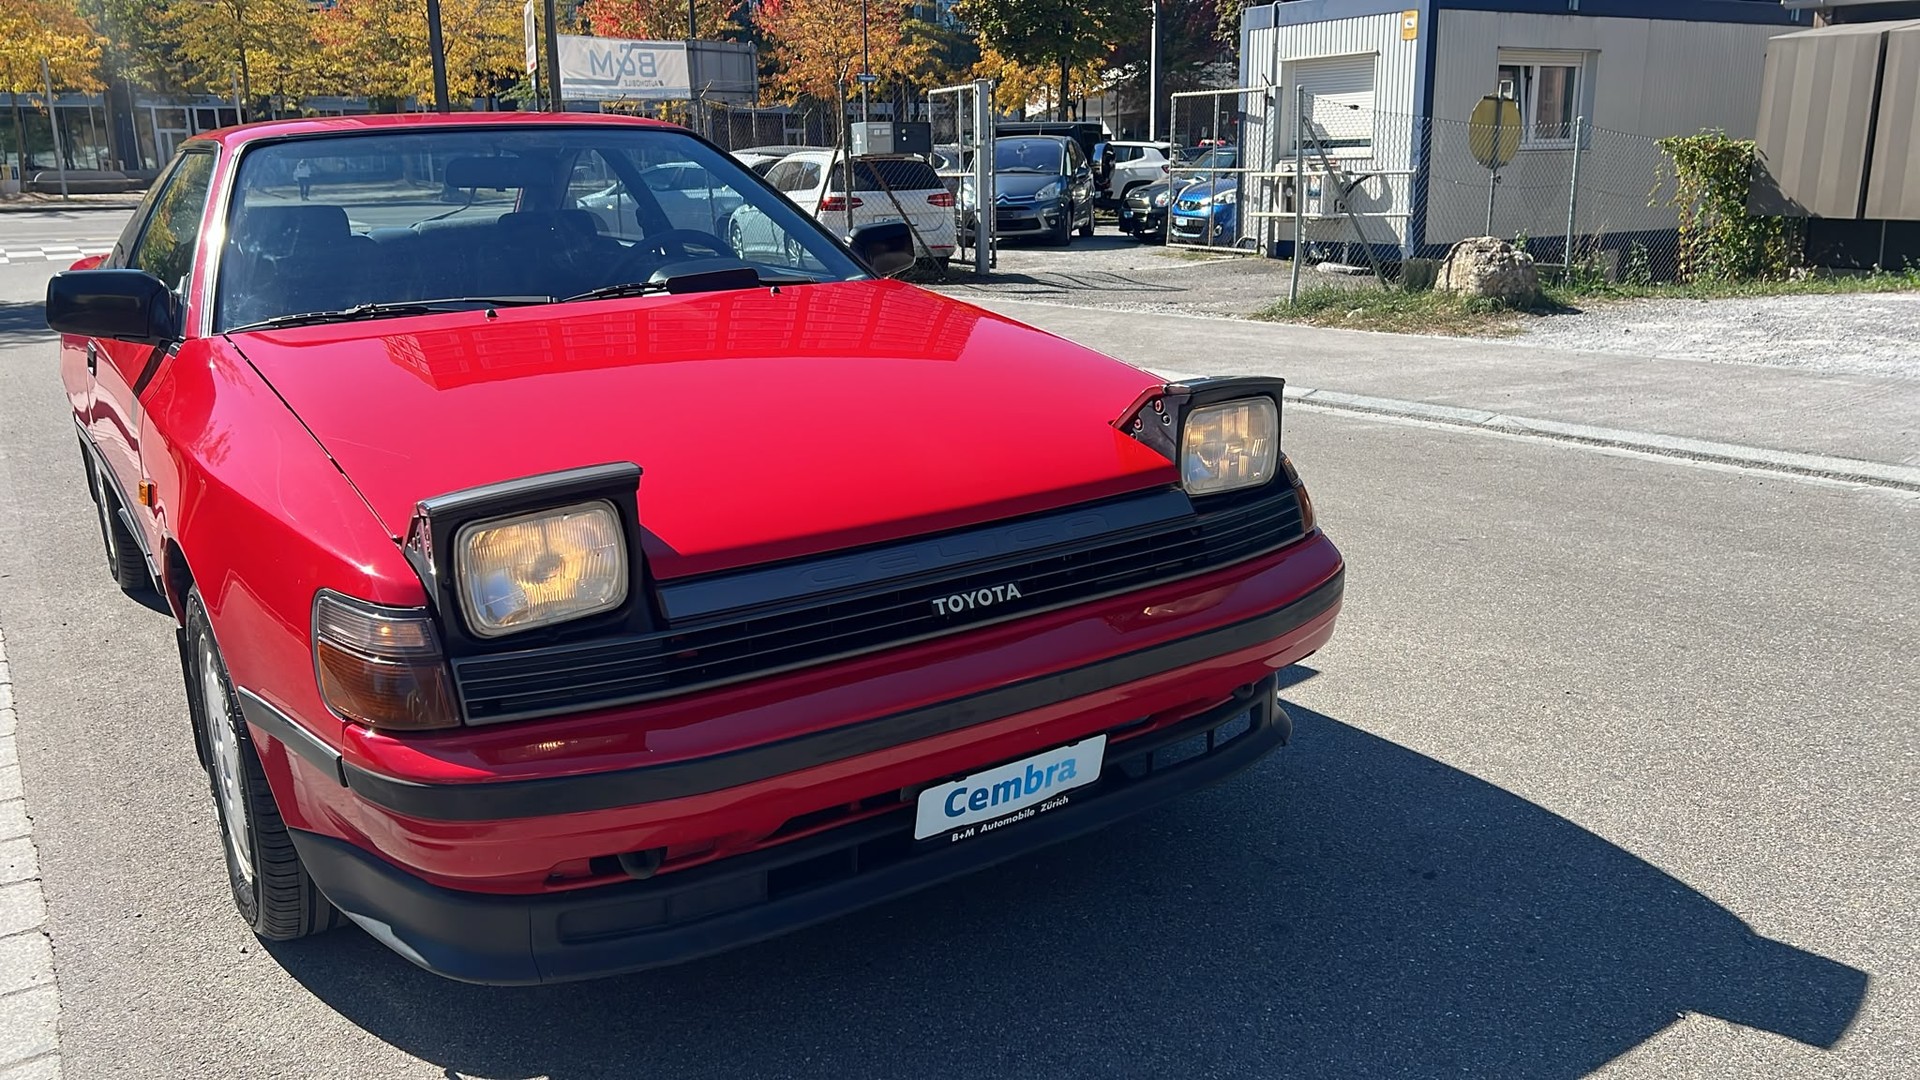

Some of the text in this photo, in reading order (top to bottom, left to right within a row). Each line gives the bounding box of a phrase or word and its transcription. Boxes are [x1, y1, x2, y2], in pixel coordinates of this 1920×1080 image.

[799, 512, 1110, 587] CELICA
[933, 583, 1022, 616] TOYOTA
[944, 758, 1077, 818] Cembra
[951, 795, 1069, 842] B+M Automobile Zürich
